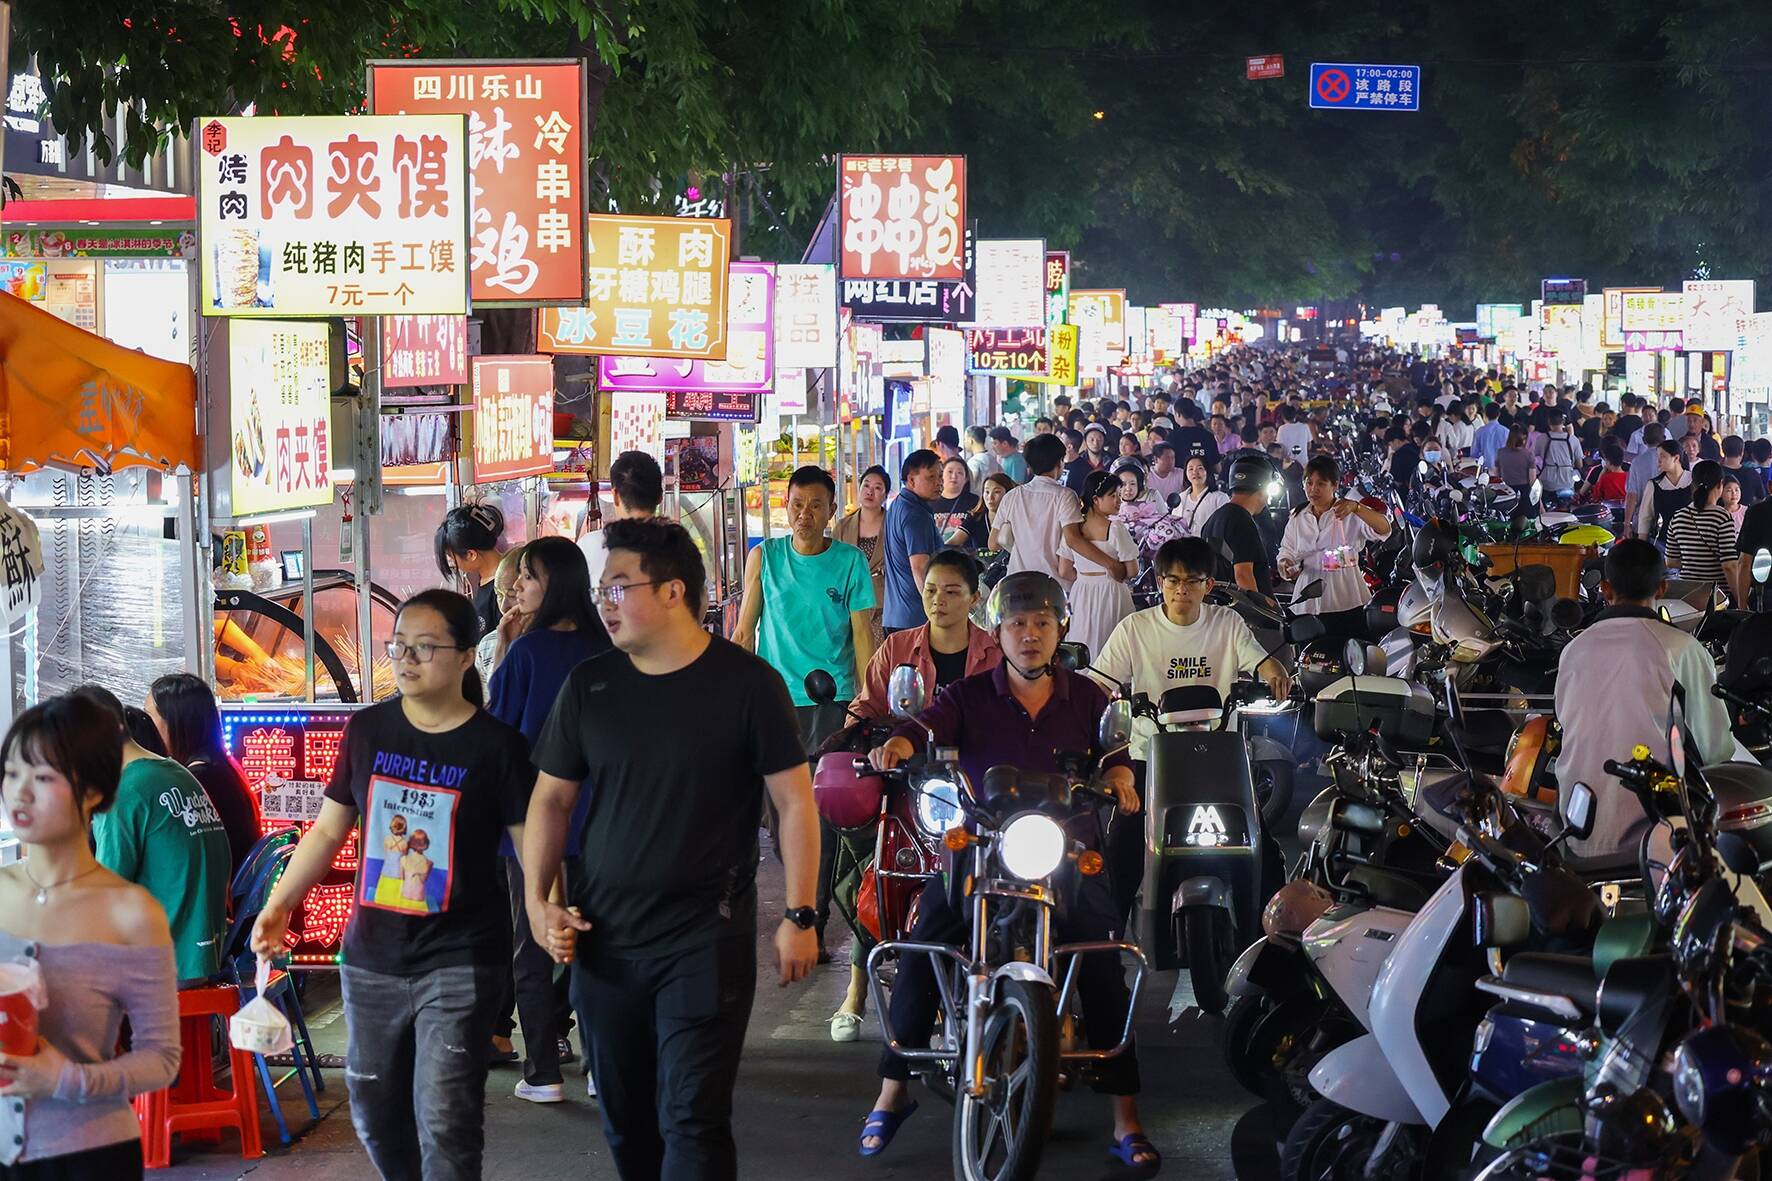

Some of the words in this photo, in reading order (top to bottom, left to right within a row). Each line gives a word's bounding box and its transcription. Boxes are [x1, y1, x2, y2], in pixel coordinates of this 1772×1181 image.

[413, 74, 542, 100] 四川乐山
[1355, 79, 1412, 92] 该路段
[1356, 69, 1412, 78] 17:00-02:00
[1355, 92, 1412, 105] 严禁停车
[206, 124, 222, 153] 李记
[218, 154, 248, 220] 烤肉
[260, 133, 449, 220] 肉夹馍
[533, 110, 572, 253] 冷串串
[845, 160, 960, 275] 串串香
[283, 240, 455, 274] 纯猪肉手工馍
[589, 226, 713, 268] 酥肉
[327, 282, 415, 306] 7元一个
[556, 306, 710, 350] 冰豆花
[973, 351, 1045, 371] 10元10个
[276, 417, 329, 493] 肉夹馍
[1167, 667, 1212, 679] SIMPLE
[1170, 656, 1207, 668] SMILE
[373, 751, 428, 782] PURPLE
[430, 765, 468, 788] LADY
[383, 800, 435, 819] Interesting
